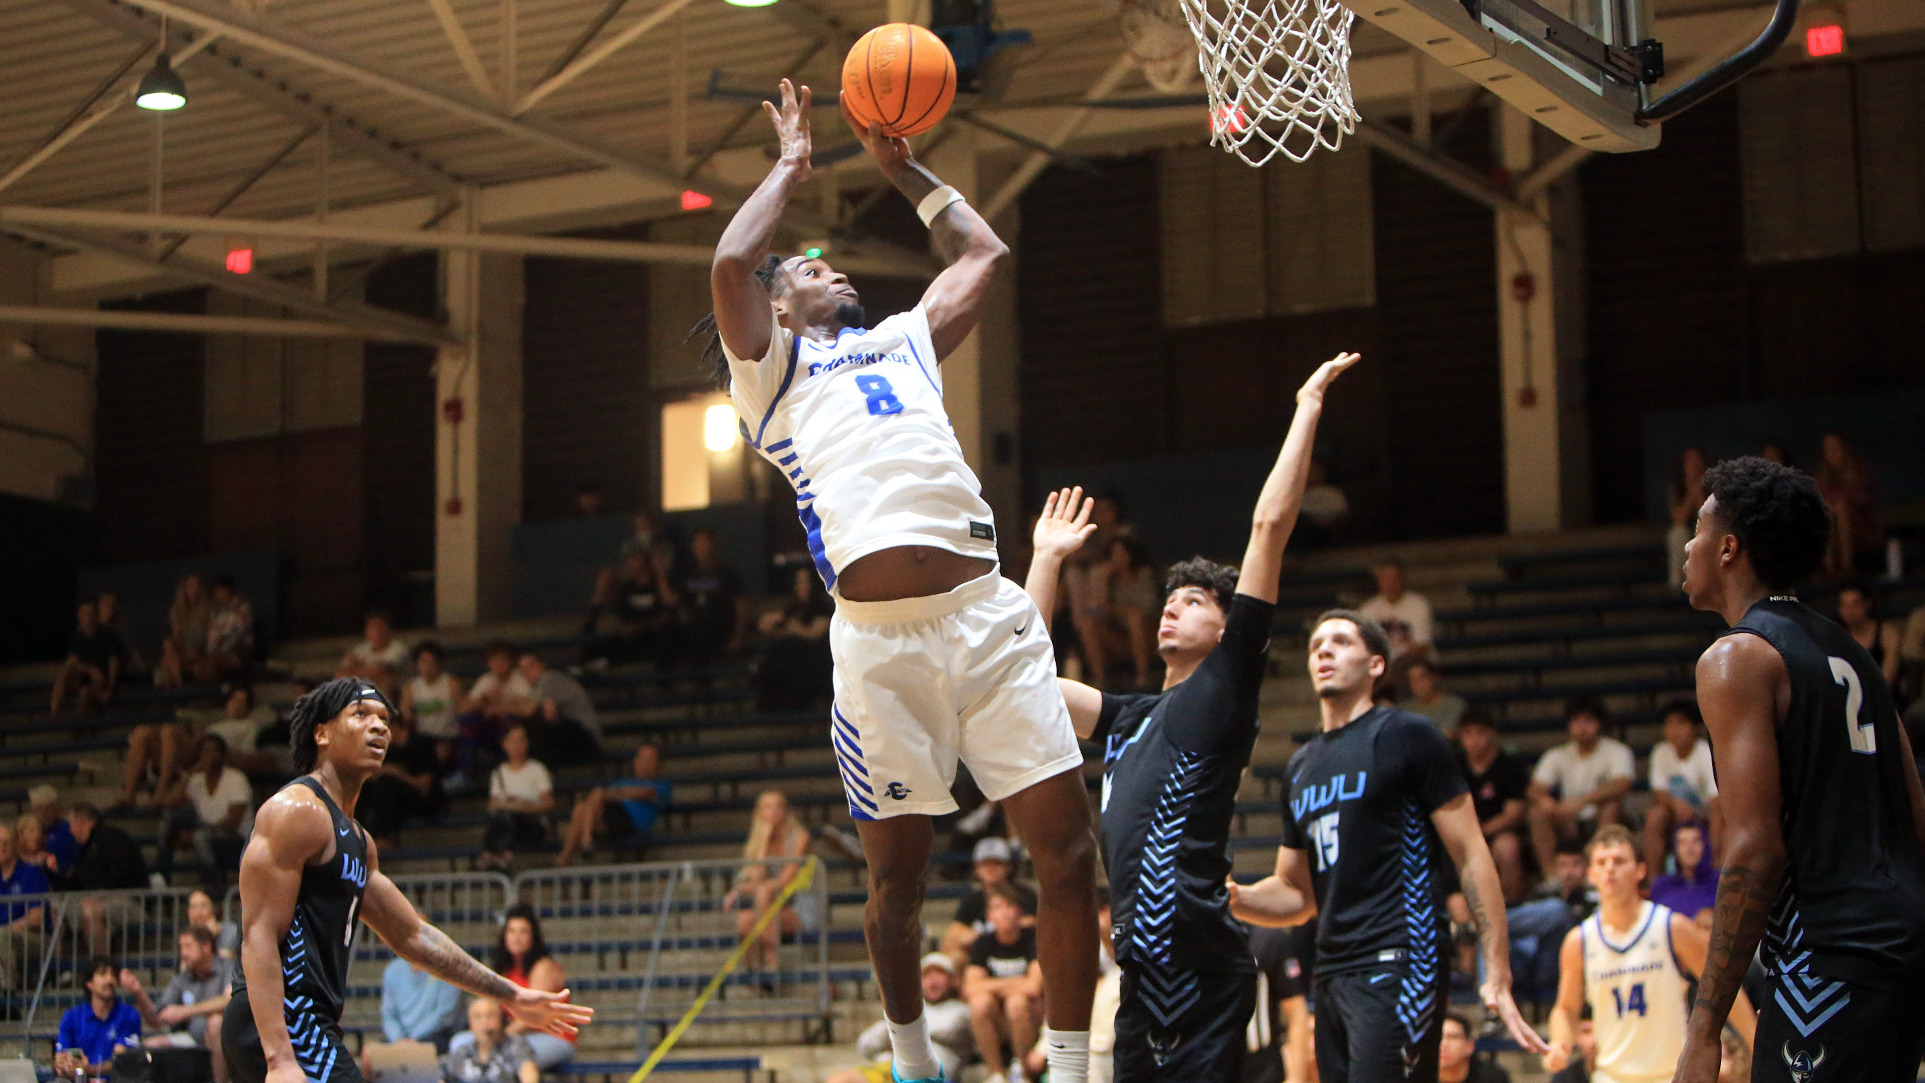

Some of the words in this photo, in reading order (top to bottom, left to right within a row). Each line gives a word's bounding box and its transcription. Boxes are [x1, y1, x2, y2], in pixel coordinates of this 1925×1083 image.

[855, 374, 904, 415] 8
[1827, 655, 1877, 755] 2
[1289, 771, 1367, 822] WWU
[1306, 811, 1340, 873] 15
[1612, 984, 1648, 1018] 14
